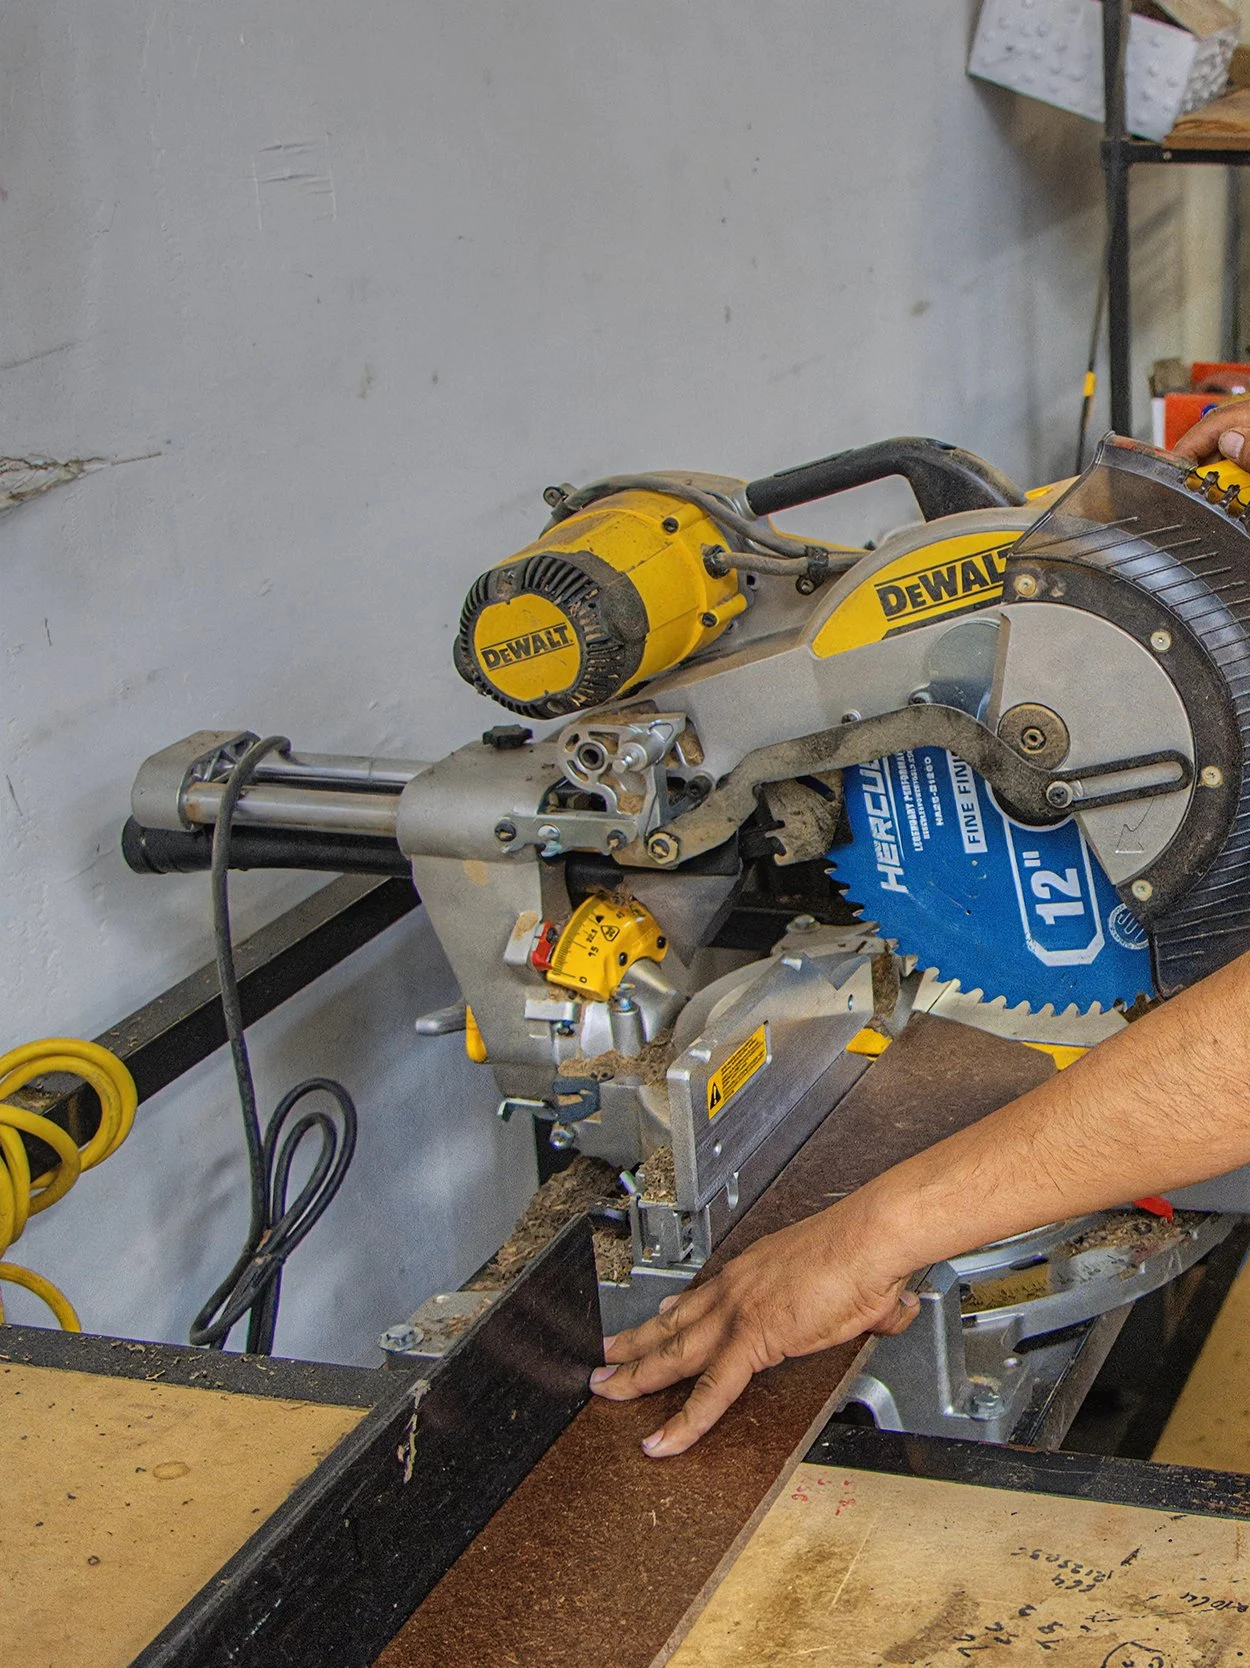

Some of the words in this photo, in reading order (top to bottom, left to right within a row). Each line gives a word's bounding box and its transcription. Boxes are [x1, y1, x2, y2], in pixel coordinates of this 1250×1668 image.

[906, 803, 924, 852] LEGENDARY
[961, 802, 981, 845] FINE
[1022, 850, 1085, 925] 12"
[587, 946, 599, 957] 15
[579, 976, 588, 984] 0
